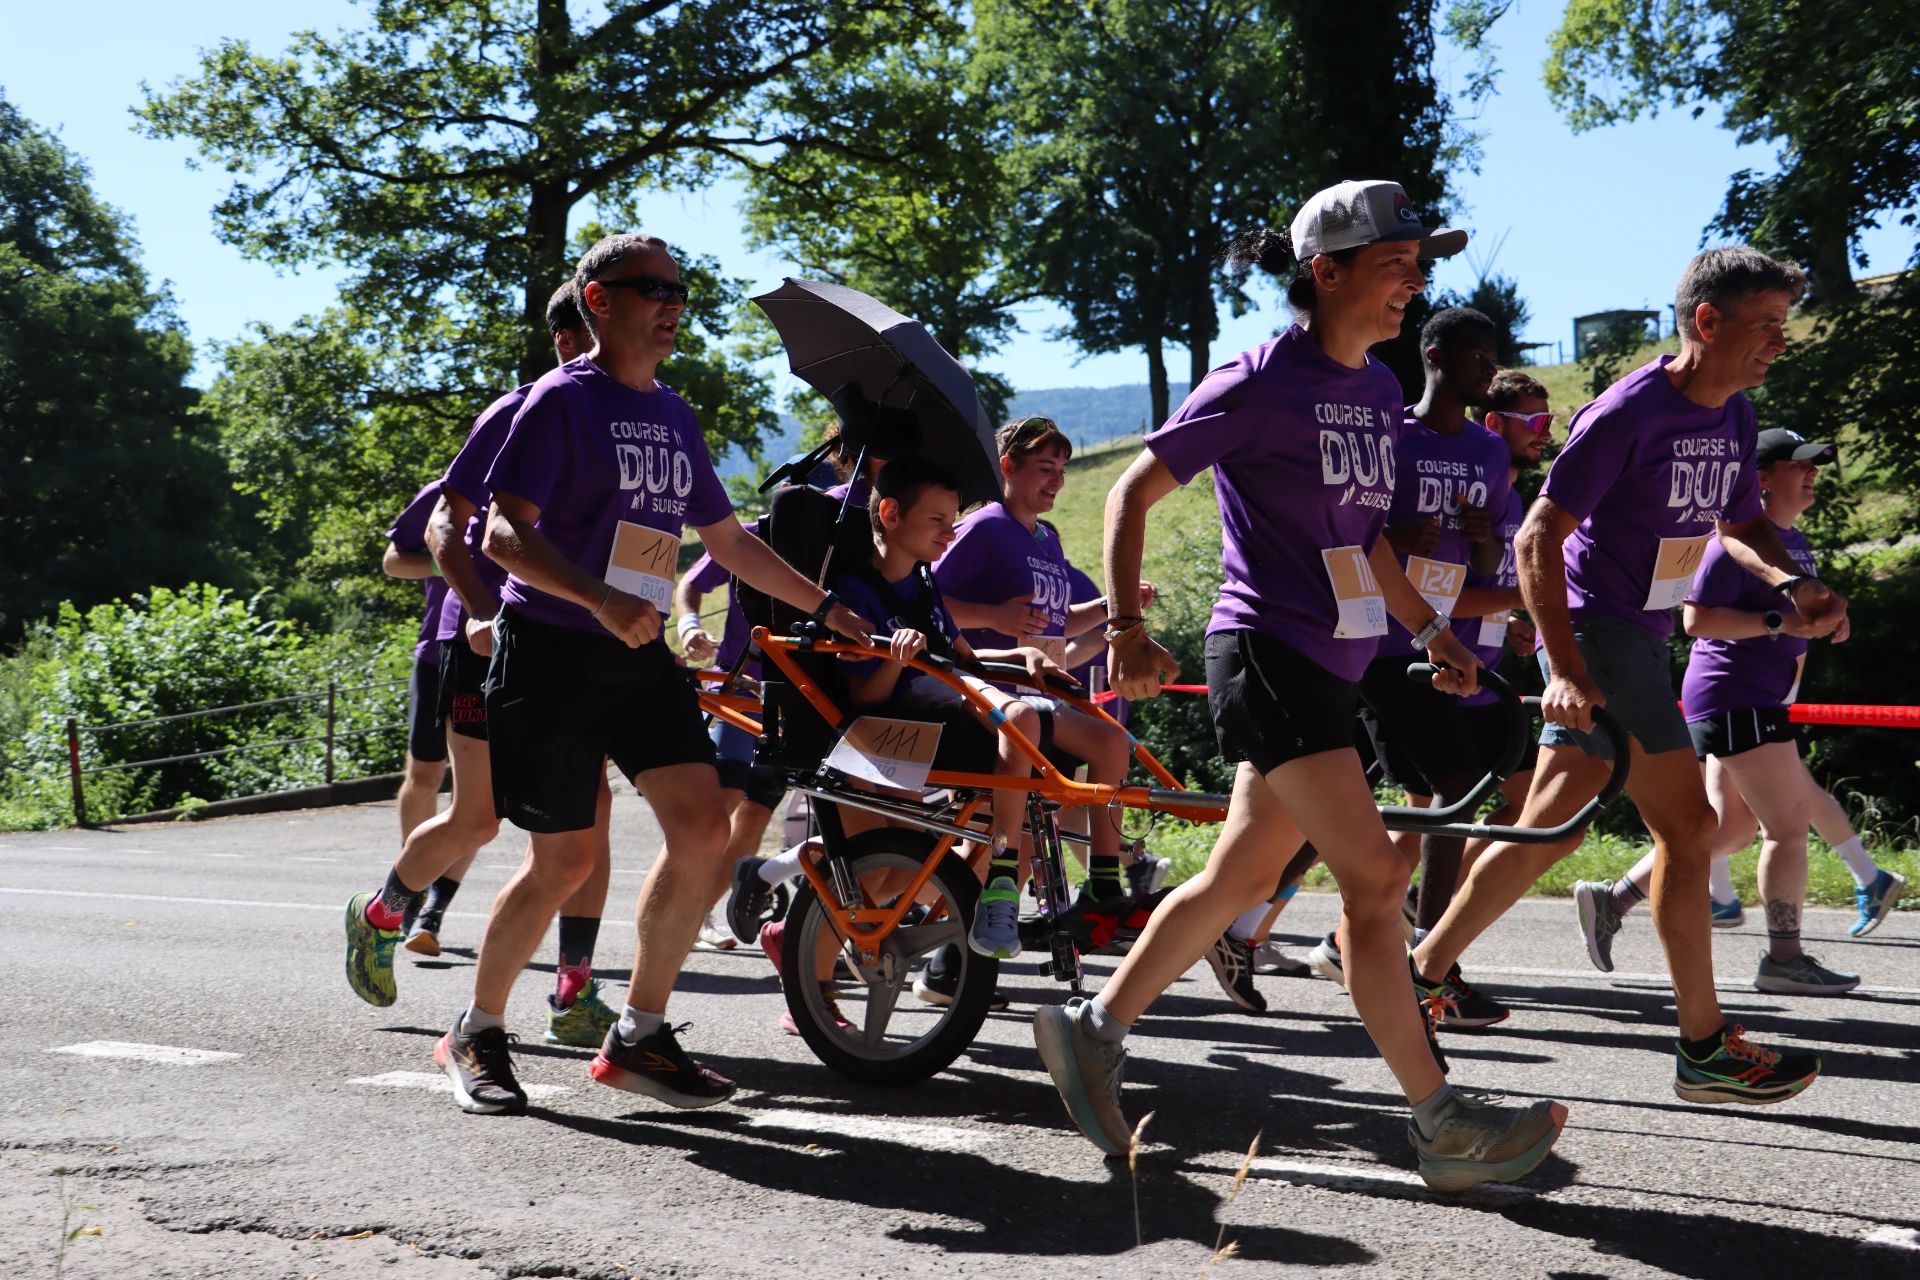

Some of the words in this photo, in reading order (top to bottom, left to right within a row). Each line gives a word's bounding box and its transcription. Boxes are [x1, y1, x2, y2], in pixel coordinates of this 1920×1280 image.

[1314, 403, 1374, 427] COURSE
[610, 421, 670, 443] COURSE
[1673, 438, 1726, 457] COURSE
[616, 444, 693, 498] DUO
[1319, 430, 1396, 491] DUO
[1416, 459, 1468, 476] COURSE
[1417, 477, 1488, 516] DUO
[1667, 461, 1741, 508] DUO
[1026, 556, 1061, 575] COURSE
[1418, 563, 1457, 594] 124
[640, 582, 665, 601] DUO
[1807, 704, 1920, 721] RAIFFEISEN
[872, 724, 920, 757] 111
